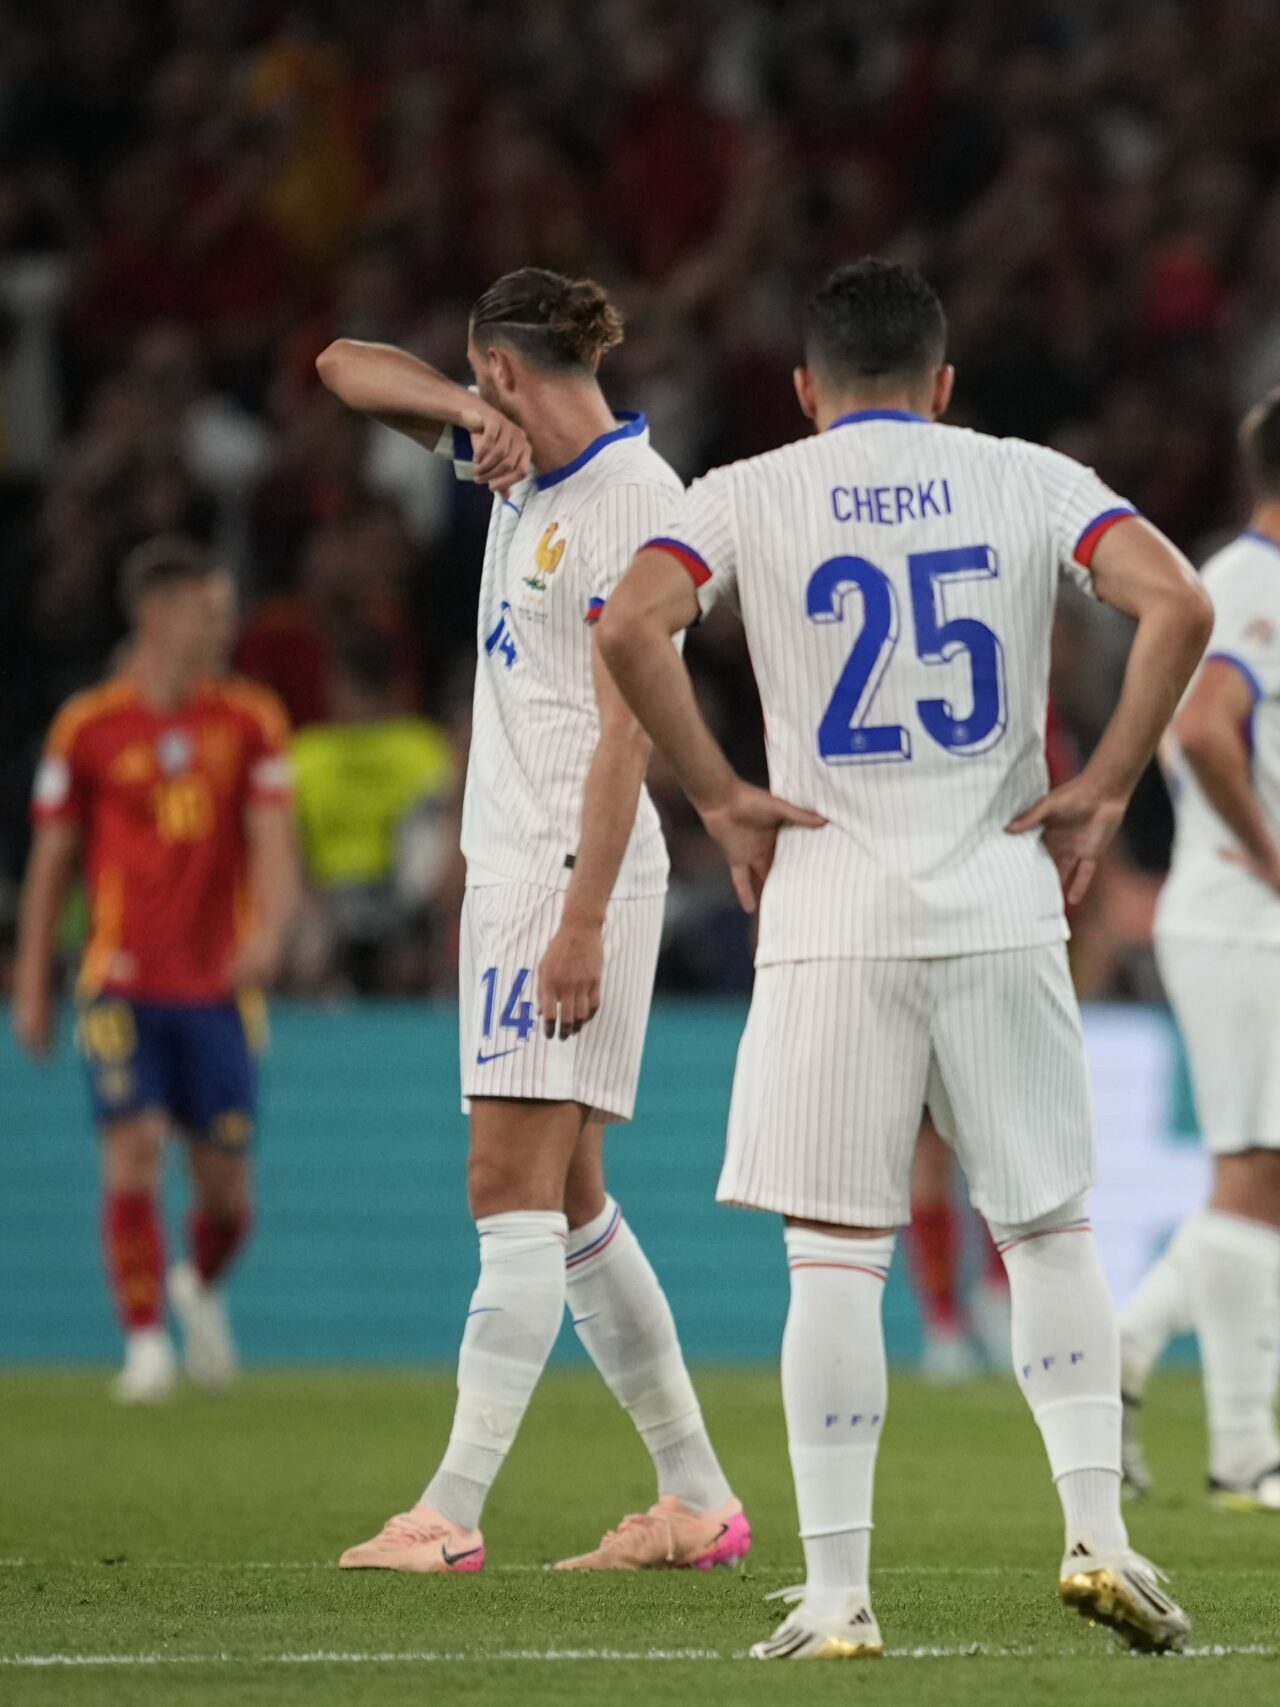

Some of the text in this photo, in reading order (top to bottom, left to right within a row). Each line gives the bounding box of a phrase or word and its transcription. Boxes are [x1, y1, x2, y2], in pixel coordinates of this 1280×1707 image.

[831, 479, 952, 525] CHERKI
[806, 544, 1008, 767] 25
[482, 966, 536, 1041] 14
